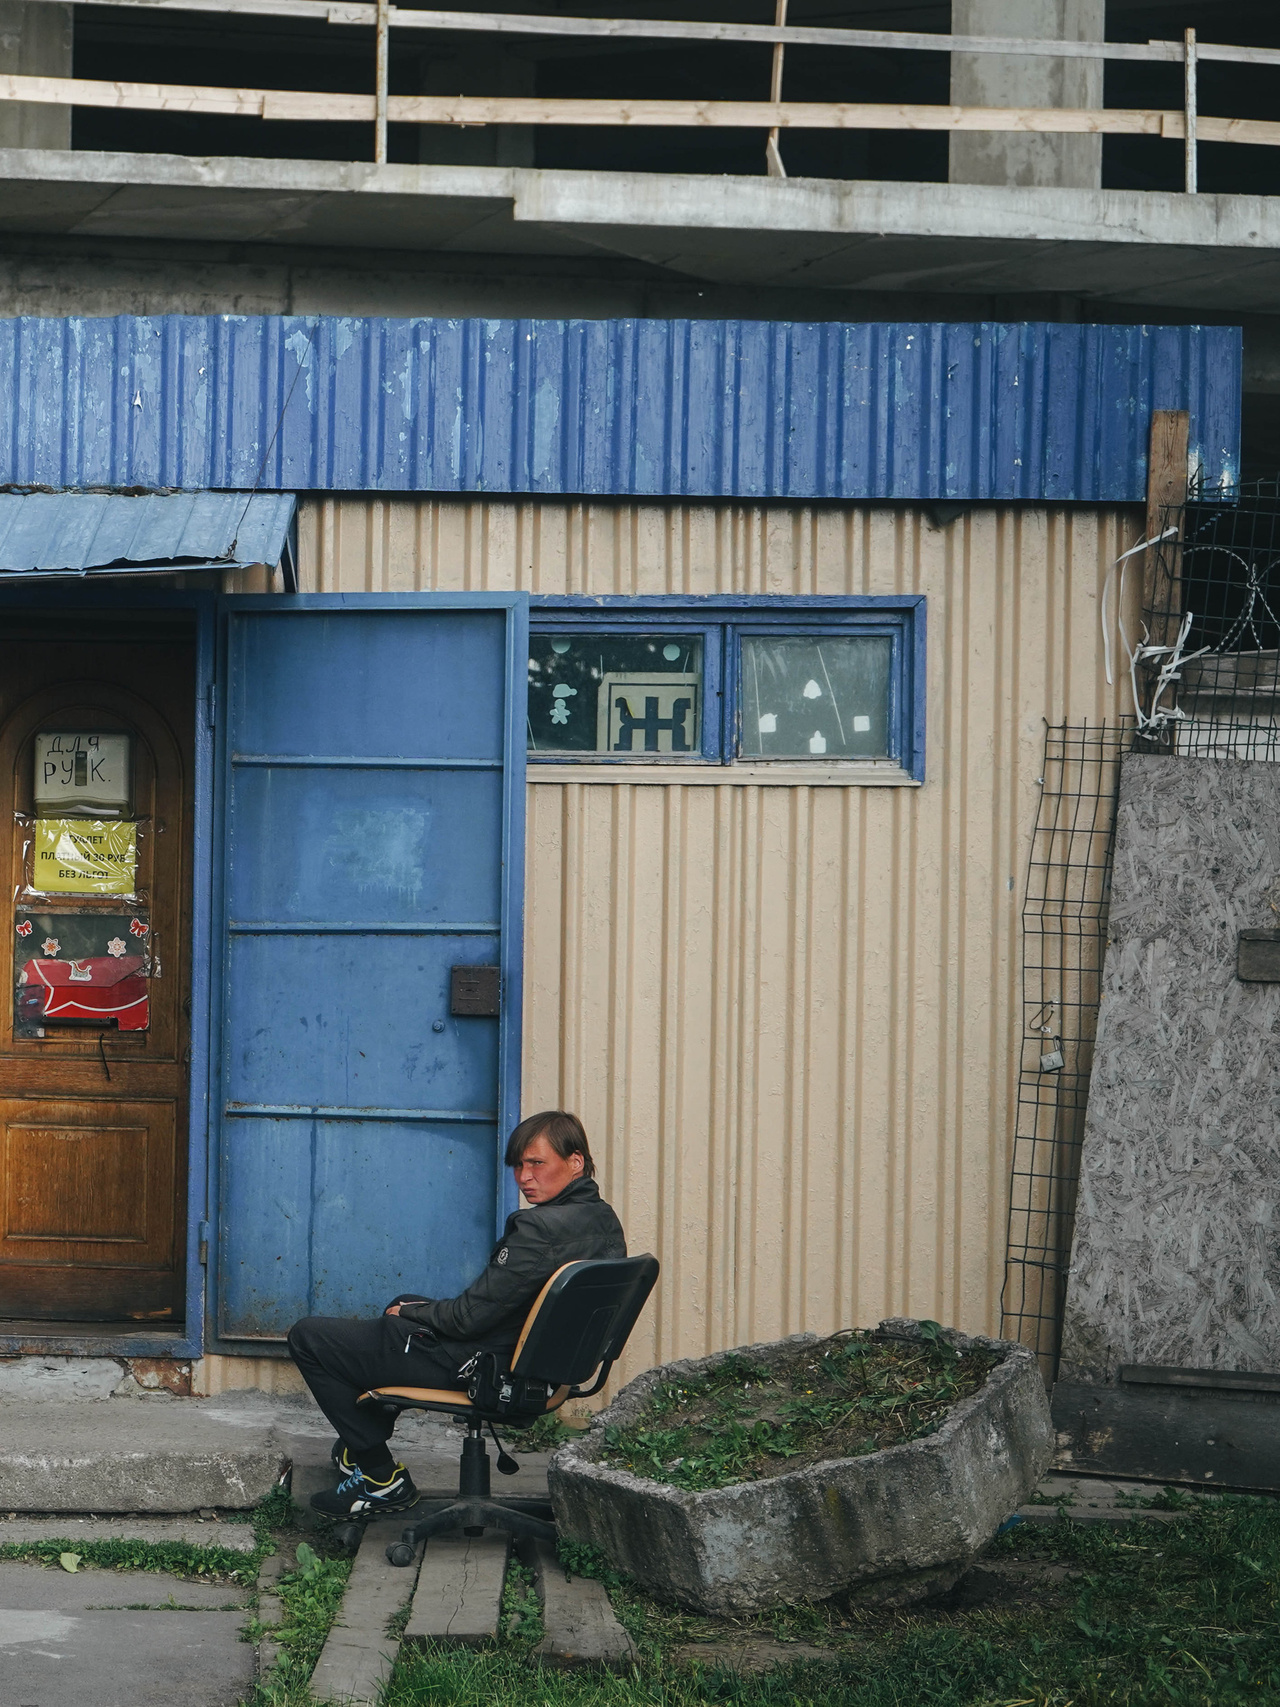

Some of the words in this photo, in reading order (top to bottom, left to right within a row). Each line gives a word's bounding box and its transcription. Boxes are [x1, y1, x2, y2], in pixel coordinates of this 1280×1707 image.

[614, 696, 692, 751] Ж
[47, 735, 100, 757] ДЛЯ
[67, 834, 105, 845] УАЛЕТ
[58, 869, 76, 879] БЕЗ
